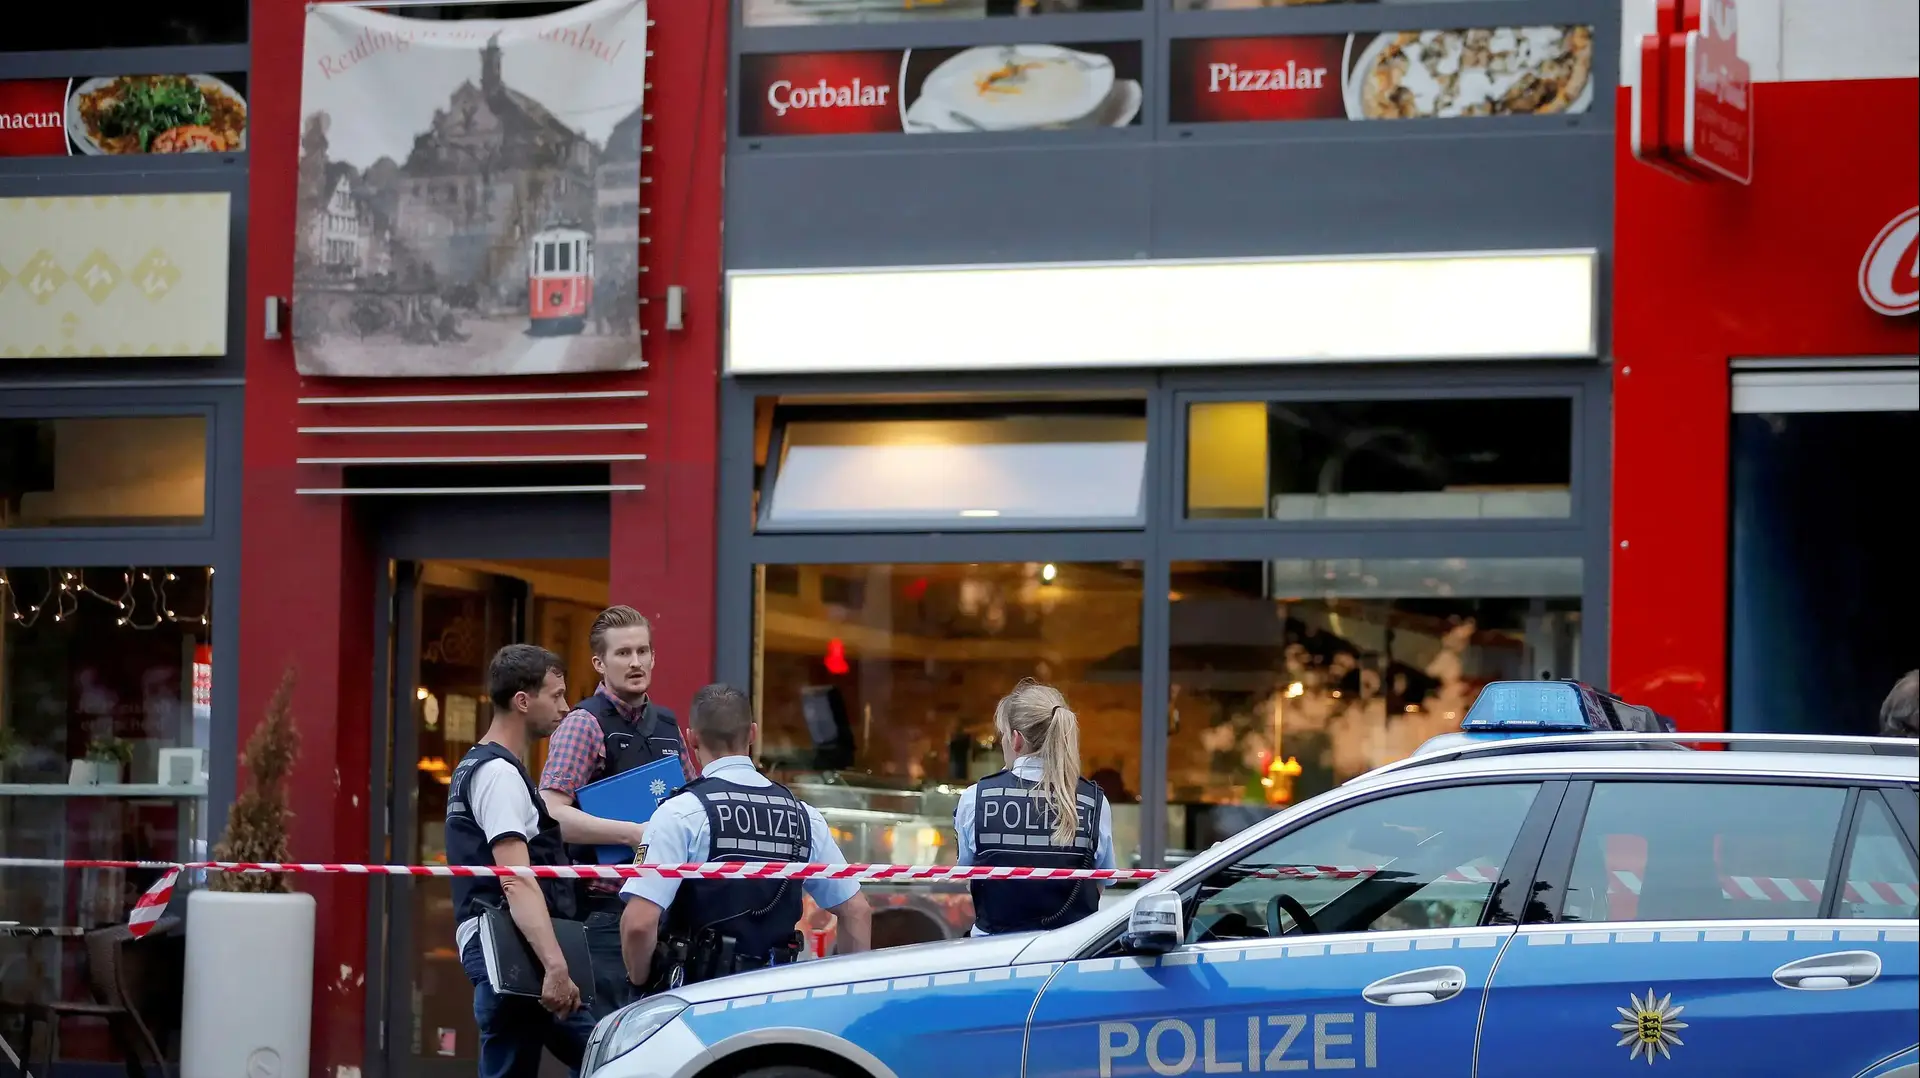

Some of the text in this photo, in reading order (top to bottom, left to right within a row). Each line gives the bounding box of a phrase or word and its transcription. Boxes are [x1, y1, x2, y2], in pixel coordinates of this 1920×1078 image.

[1208, 60, 1328, 93] Pizzalar
[767, 76, 891, 116] Çorbalar
[716, 804, 807, 841] POLIZEI
[1099, 1011, 1377, 1078] POLIZEI
